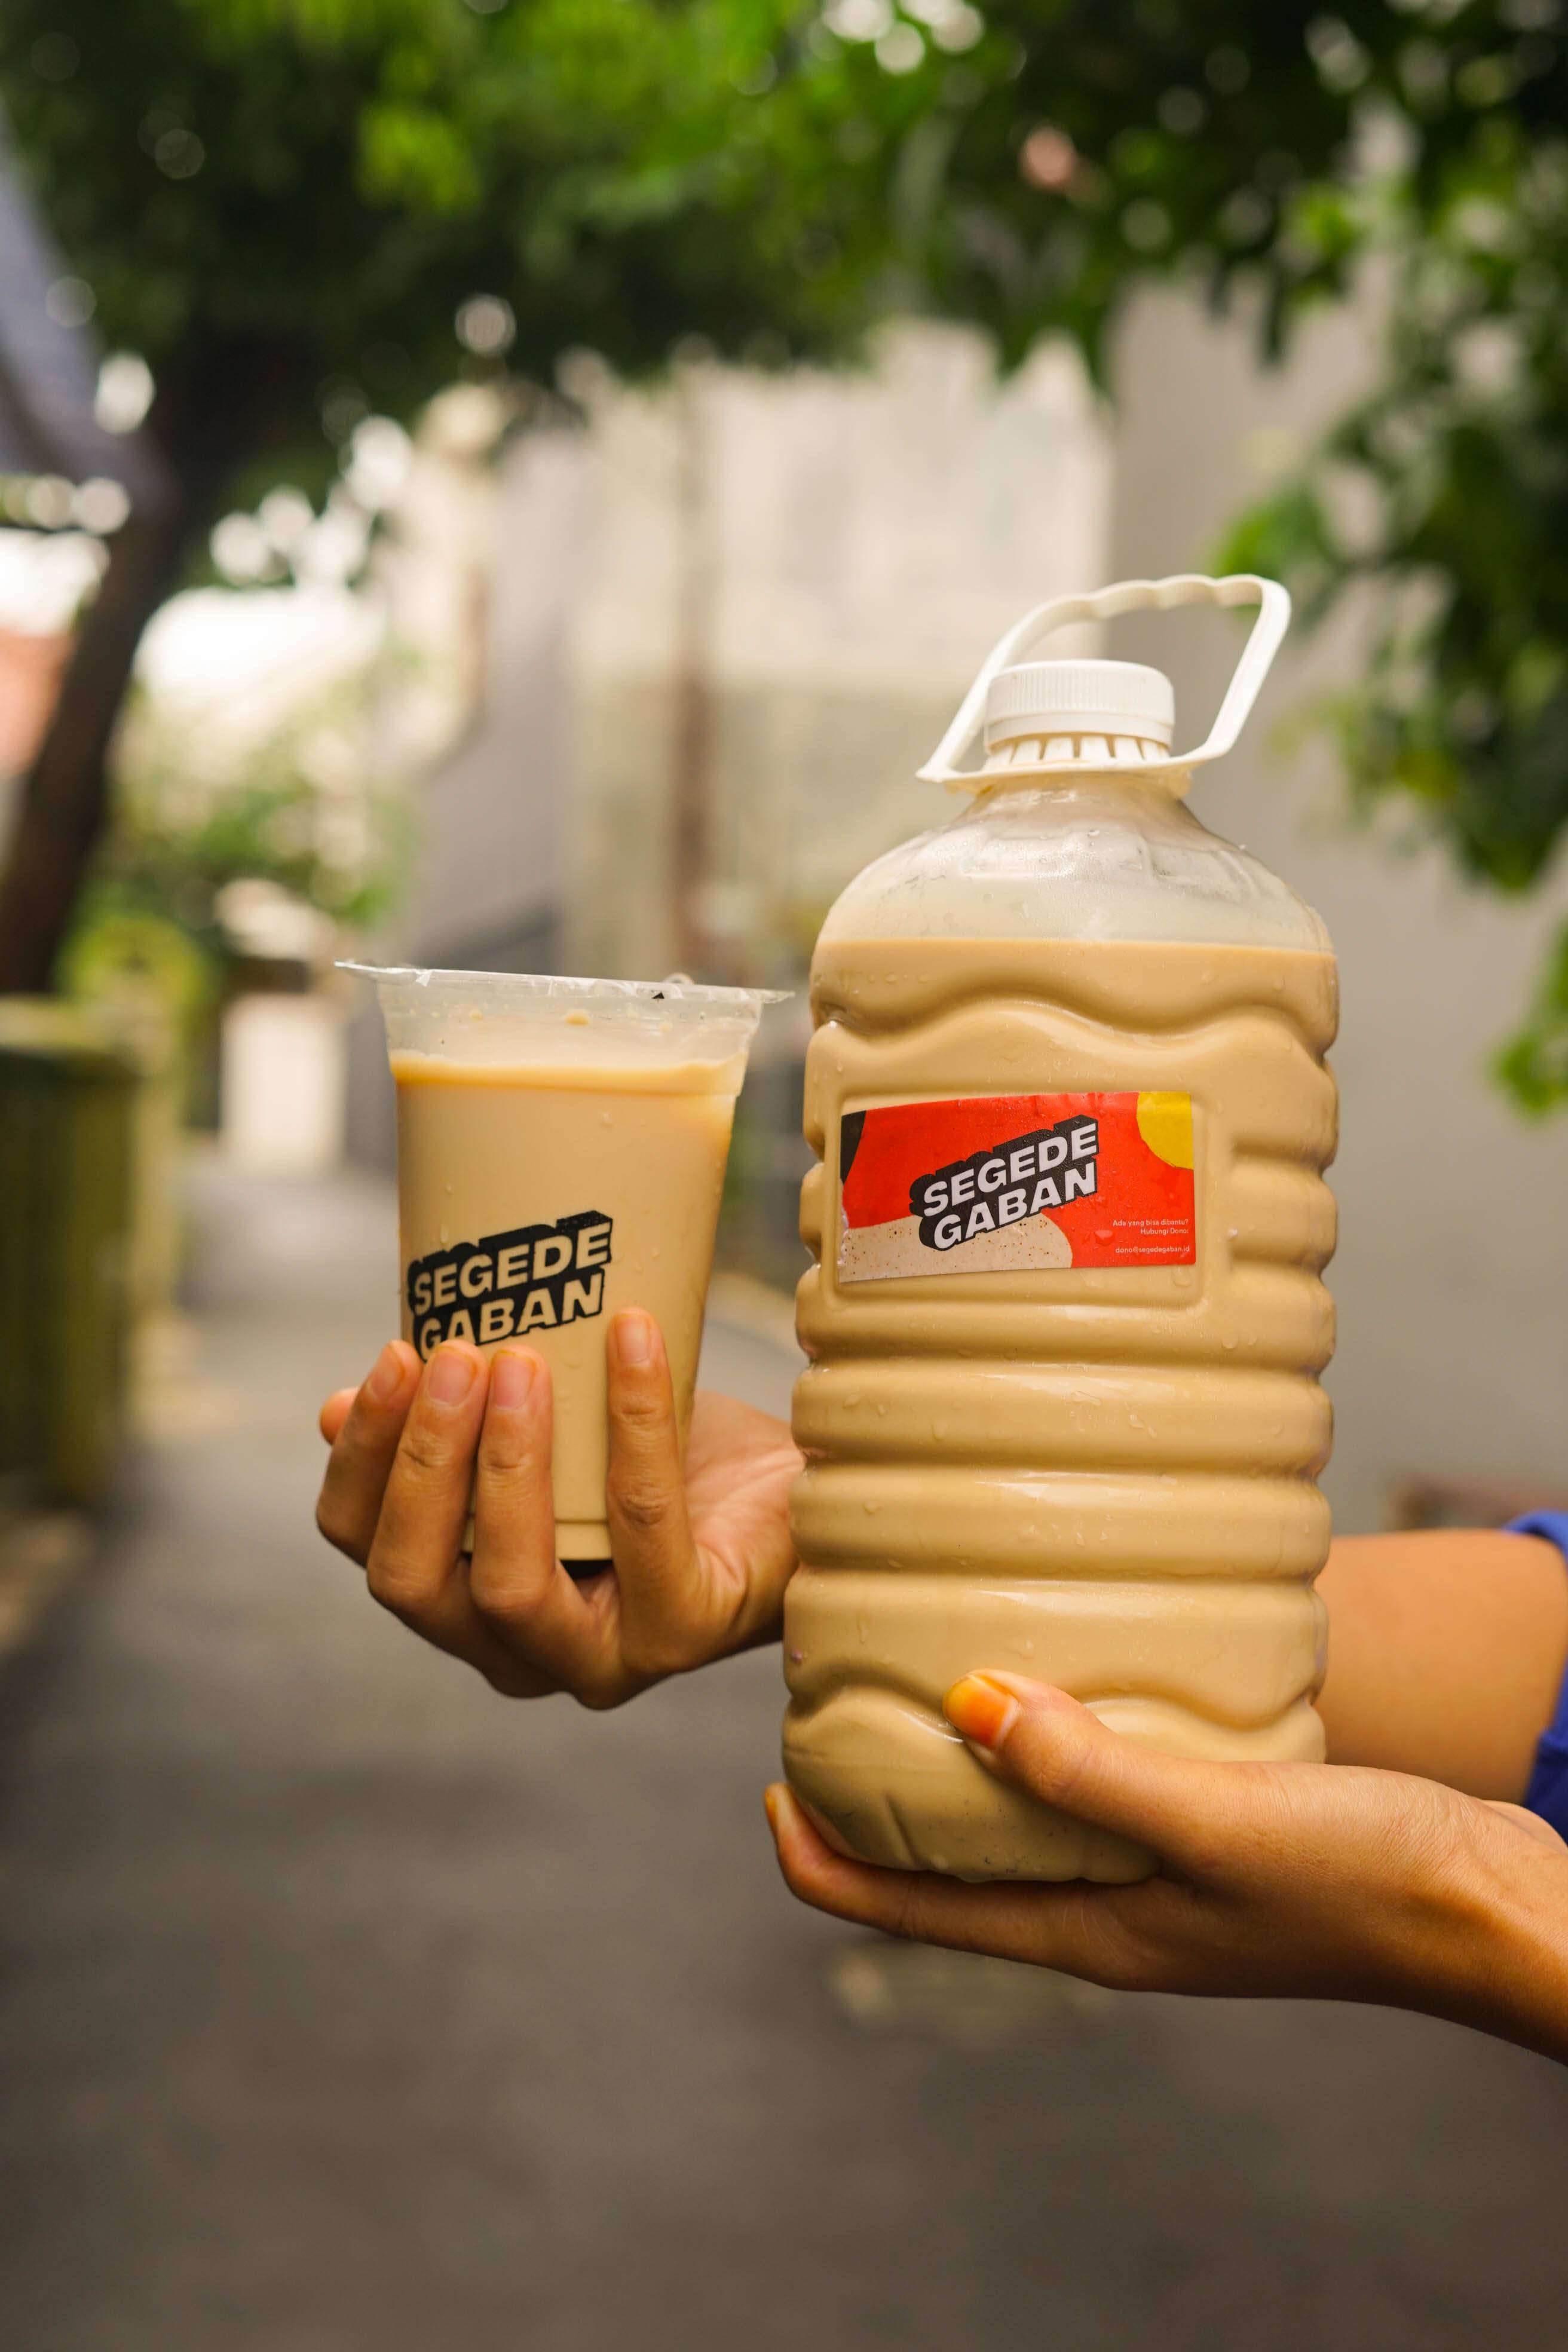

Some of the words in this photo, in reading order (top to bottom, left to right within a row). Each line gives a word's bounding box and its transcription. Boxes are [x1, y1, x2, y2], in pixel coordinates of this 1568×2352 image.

[923, 1122, 1098, 1217] SEGEDE
[933, 1162, 1095, 1250] GABAN
[414, 1221, 611, 1315] SEGEDE
[421, 1272, 602, 1362] GABAN
